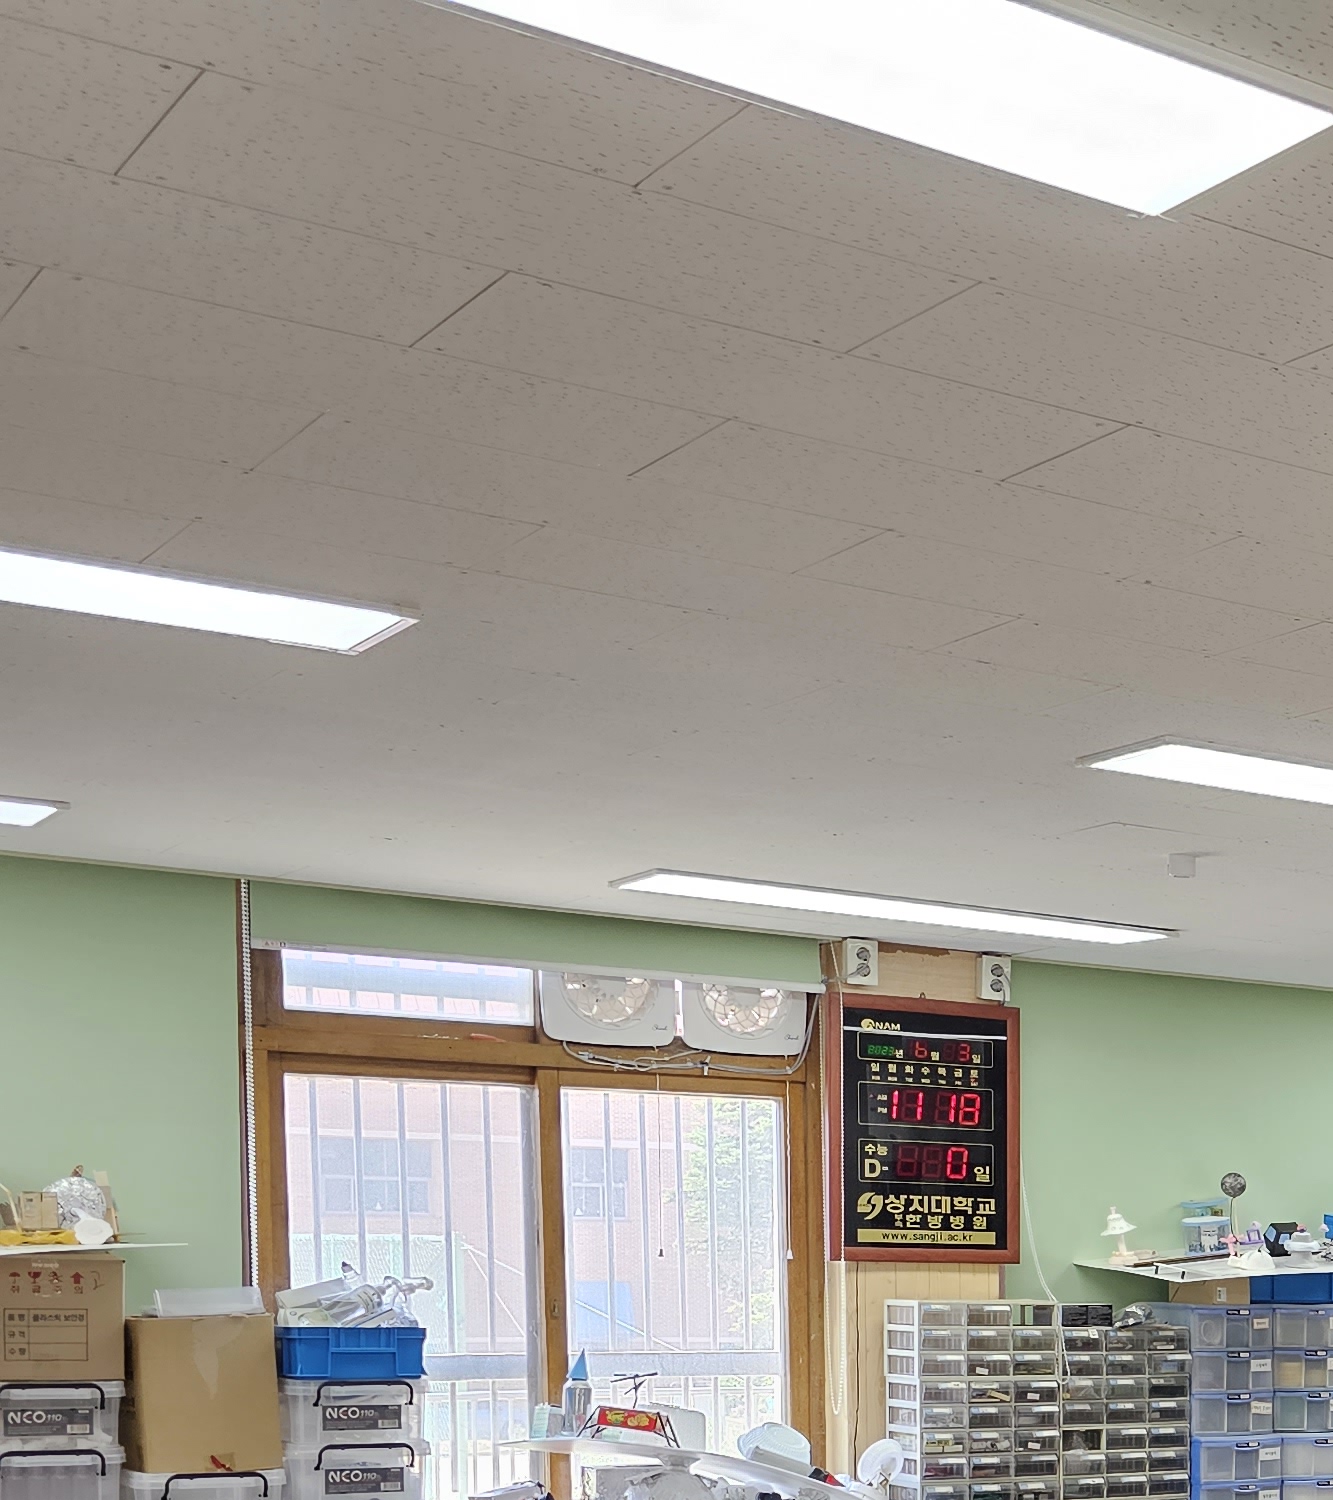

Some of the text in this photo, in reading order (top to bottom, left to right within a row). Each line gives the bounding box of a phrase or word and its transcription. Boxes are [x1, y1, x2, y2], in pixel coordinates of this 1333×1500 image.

[871, 1063, 879, 1071] 일
[864, 1143, 888, 1156] 수능
[974, 1166, 990, 1182] 일
[885, 1194, 997, 1215] 상지대학교
[881, 1231, 973, 1243] www.sangji.ac.kr
